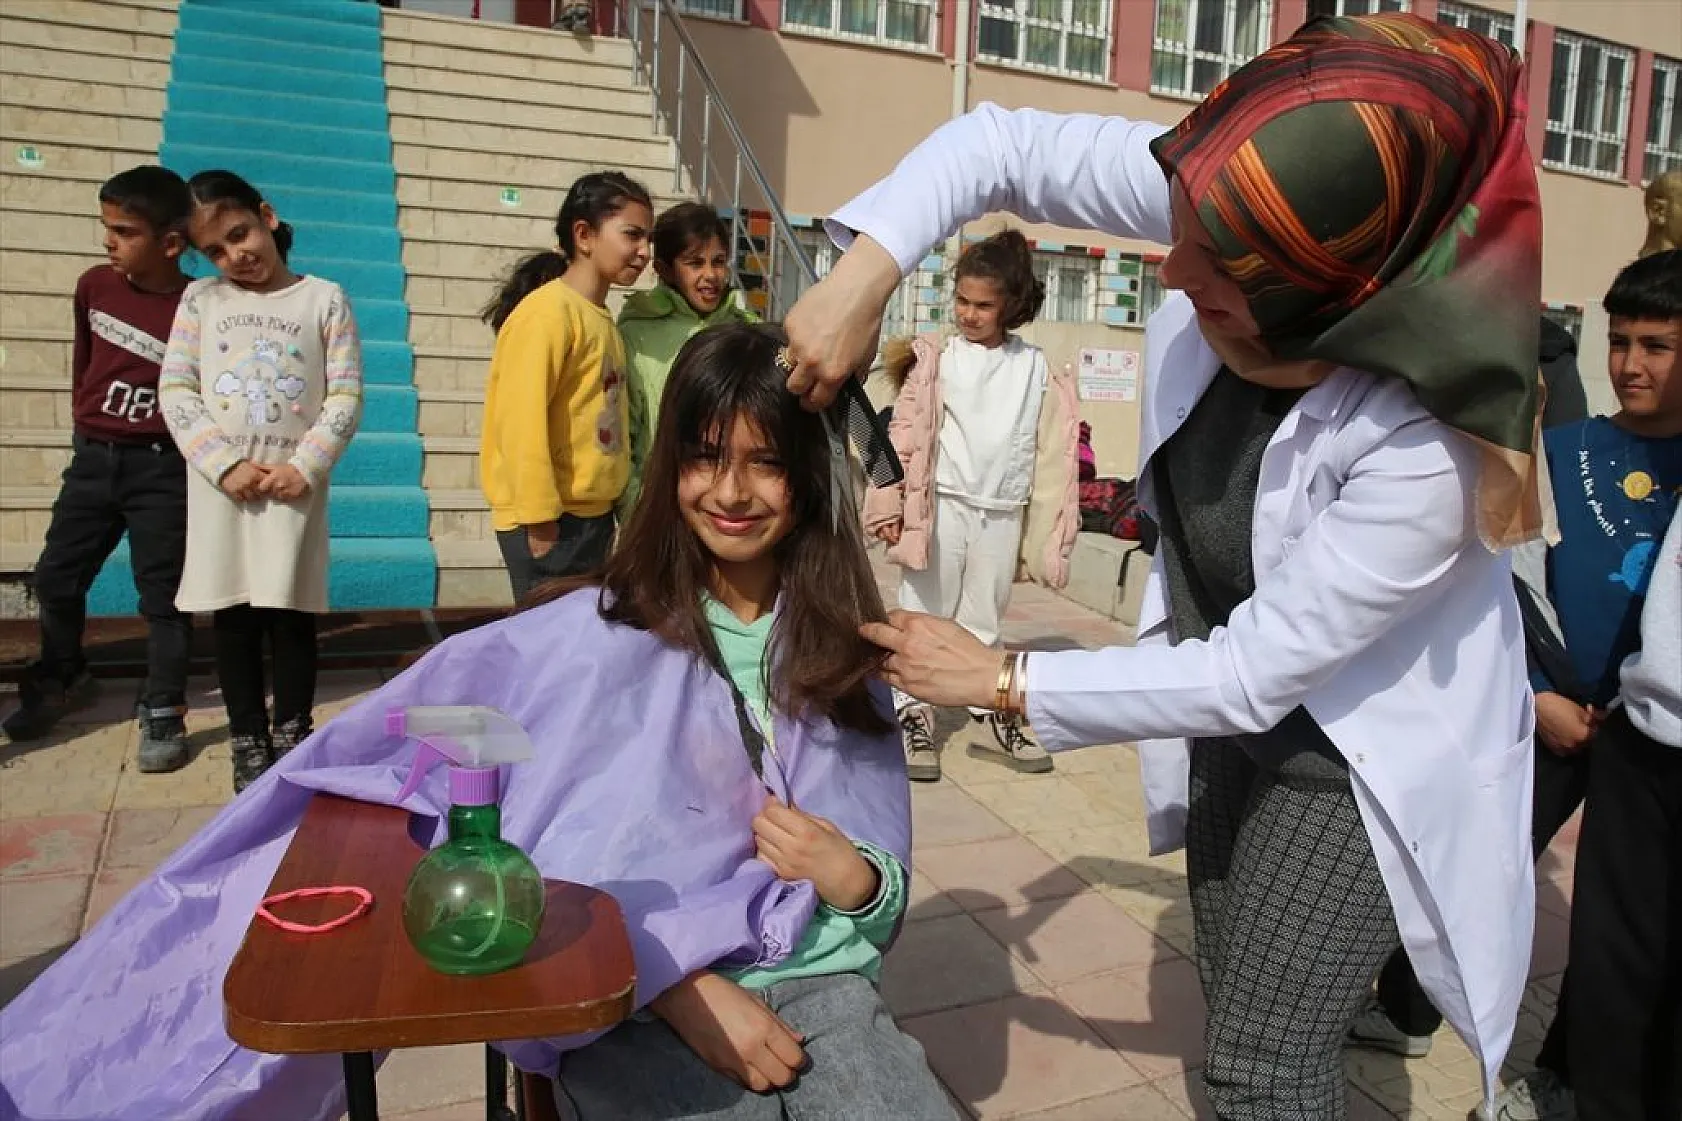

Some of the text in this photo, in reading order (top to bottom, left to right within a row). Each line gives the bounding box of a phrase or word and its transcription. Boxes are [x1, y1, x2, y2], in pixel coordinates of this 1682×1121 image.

[215, 313, 302, 338] CATICORN POWER
[102, 380, 157, 423] 08
[1583, 478, 1595, 498] the
